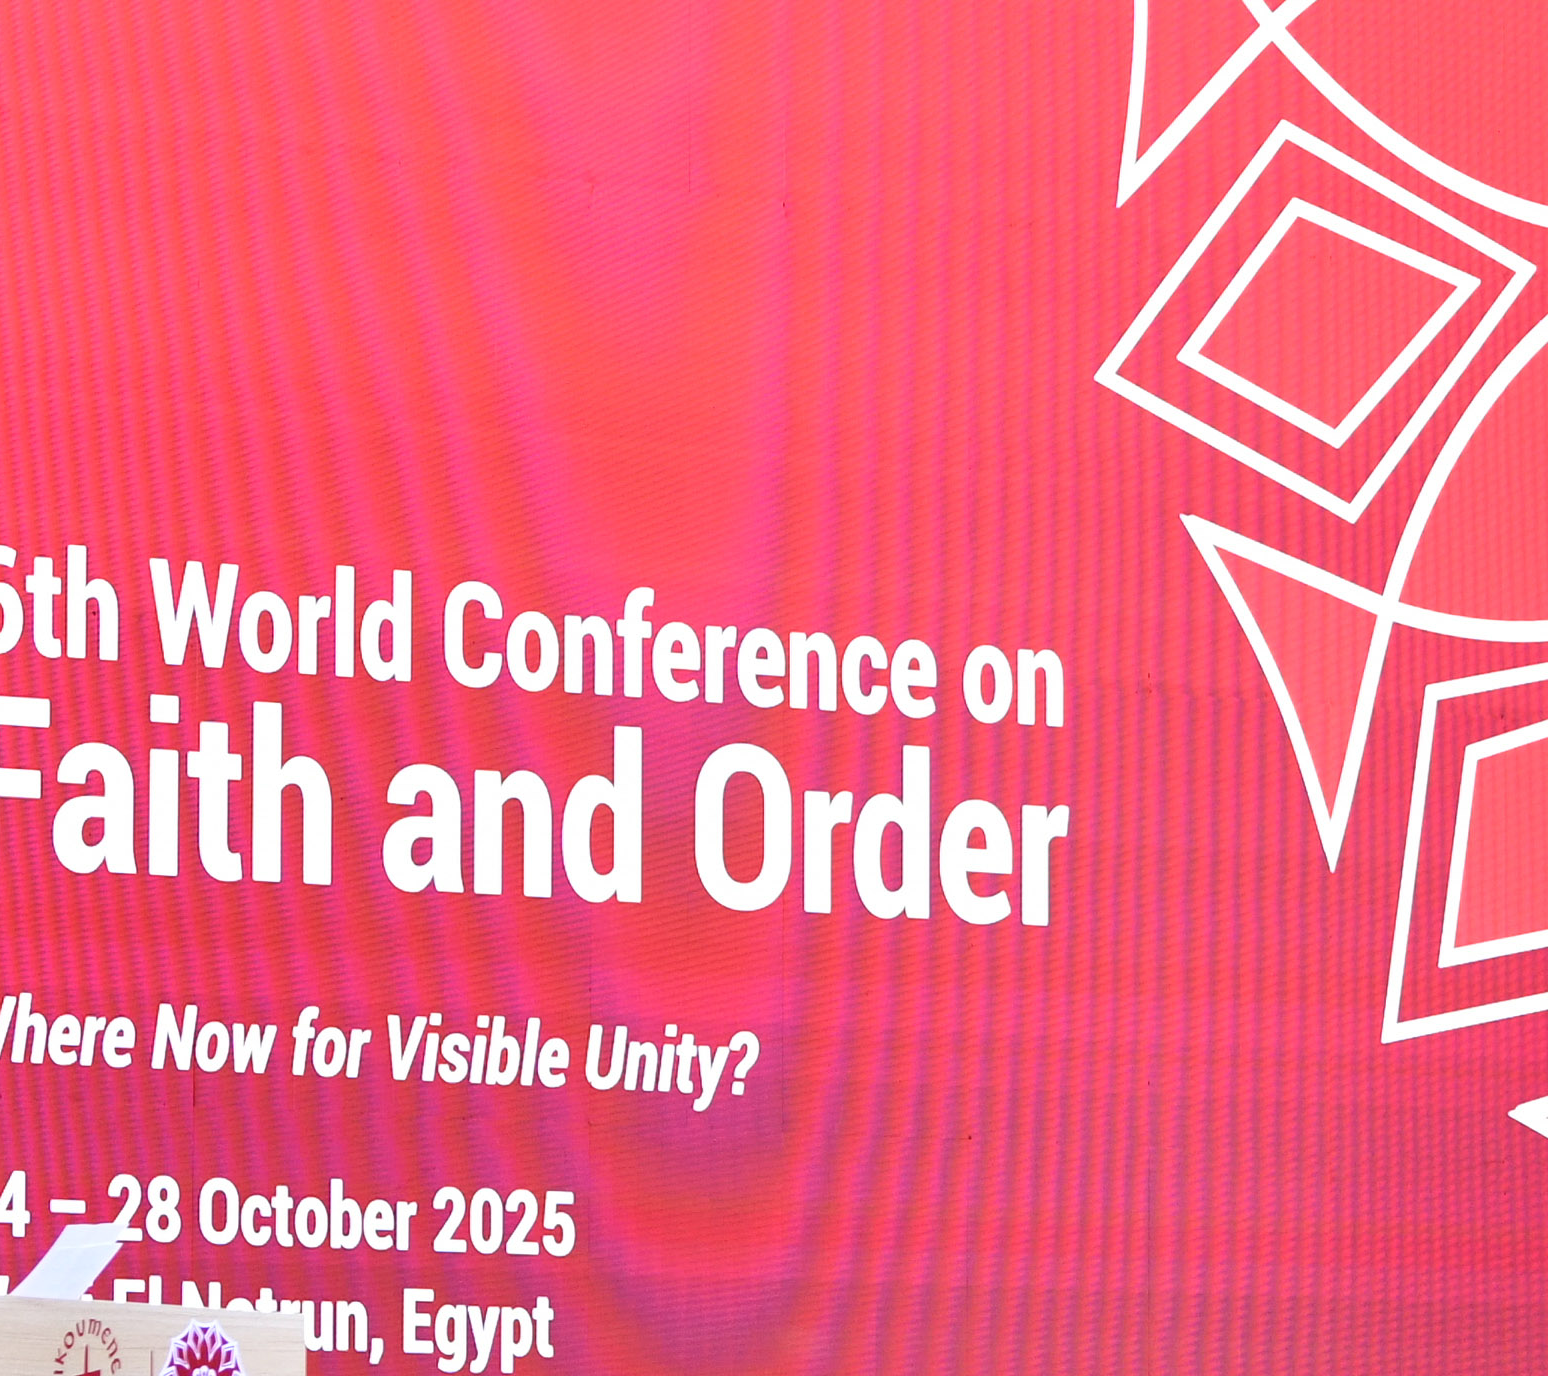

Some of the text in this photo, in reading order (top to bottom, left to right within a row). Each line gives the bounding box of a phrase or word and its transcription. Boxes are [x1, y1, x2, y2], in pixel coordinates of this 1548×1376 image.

[149, 557, 412, 682] World
[444, 581, 937, 719] Conference
[963, 644, 1064, 728] on
[382, 725, 643, 903] and
[694, 743, 1070, 927] Order
[151, 1003, 278, 1074] Now
[292, 1005, 372, 1078] for
[387, 1012, 570, 1088] Visible
[585, 1024, 760, 1112] Unity?
[107, 1173, 182, 1243] 28
[199, 1177, 418, 1251] October
[433, 1186, 576, 1257] 2025
[403, 1288, 554, 1374] Egypt
